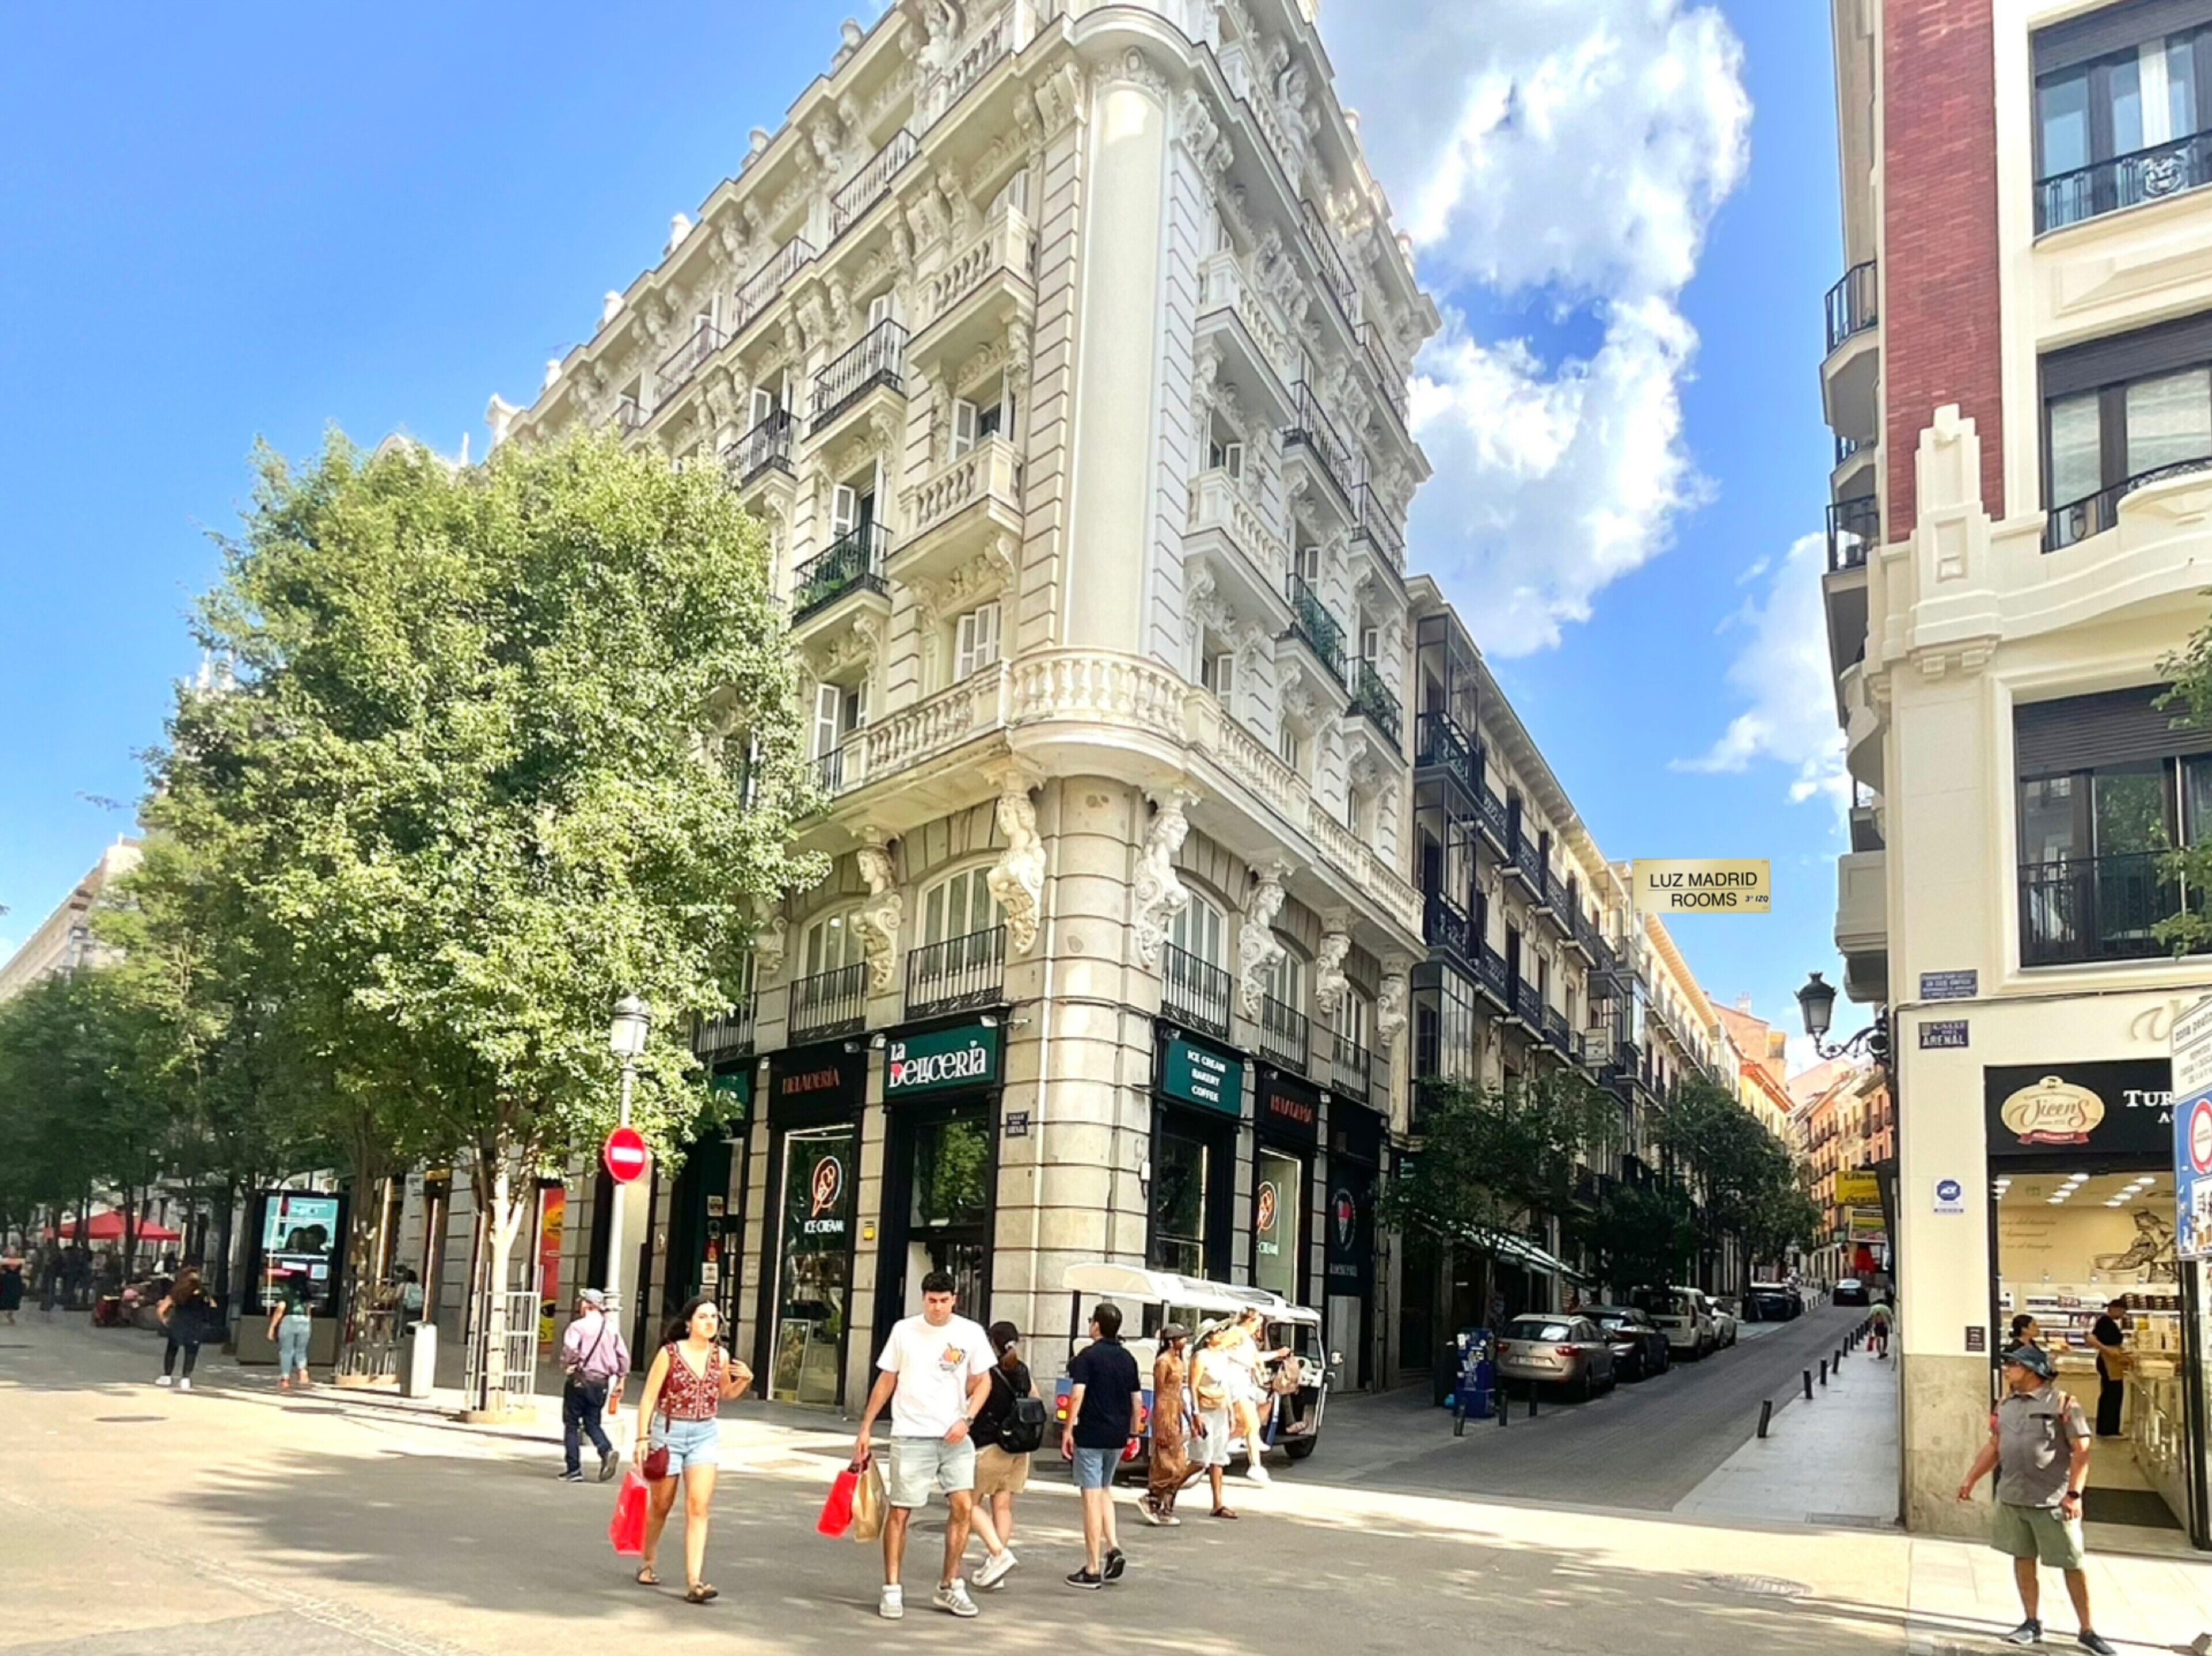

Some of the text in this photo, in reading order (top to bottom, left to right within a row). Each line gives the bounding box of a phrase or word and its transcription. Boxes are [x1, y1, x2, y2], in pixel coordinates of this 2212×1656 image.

[1922, 1034, 1965, 1046] ARENAL
[1187, 1049, 1226, 1074] ICE CREAM
[1191, 1068, 1220, 1087] BAKERY
[1191, 1085, 1219, 1103] COFFEE
